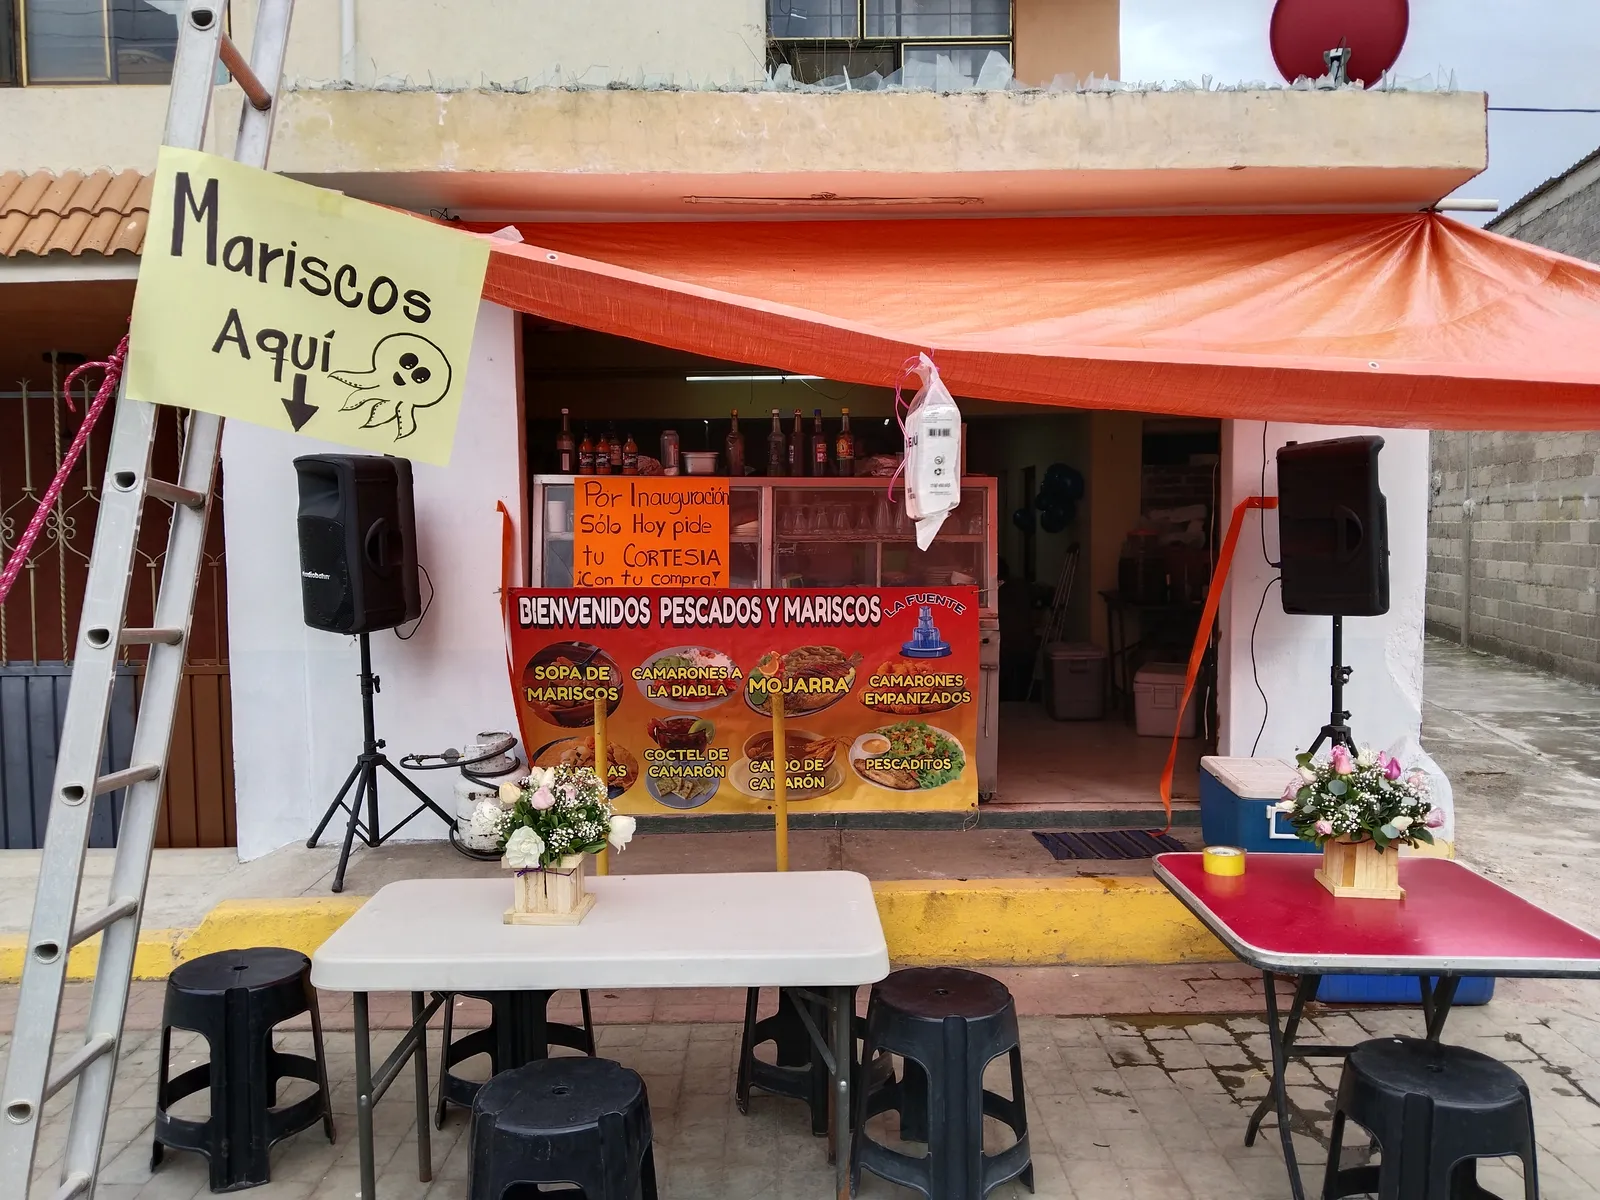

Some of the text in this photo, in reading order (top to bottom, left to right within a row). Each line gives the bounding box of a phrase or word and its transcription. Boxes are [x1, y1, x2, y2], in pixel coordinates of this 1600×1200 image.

[170, 171, 432, 324] Mariscos
[211, 308, 336, 383] Aquí
[584, 481, 729, 515] Por Inauguración
[580, 513, 712, 541] Sólo Hoy pide
[583, 543, 721, 567] tu CORTESIA
[577, 570, 721, 588] ¡Con tu compra!
[518, 595, 881, 626] BIENVENIDOS PESCADOS Y MARISCOS
[884, 593, 967, 618] LA FUENTE
[534, 666, 611, 681] SOPA DE
[631, 667, 743, 680] CAMARONES A
[869, 674, 964, 688] CAMARONES
[647, 684, 728, 698] LA DIABLA
[749, 677, 850, 694] MOJARRA
[527, 687, 619, 702] MARISCOS
[864, 691, 971, 705] EMPANIZADOS
[644, 748, 729, 761] COCTEL DE
[648, 763, 725, 778] CAMARÓN
[749, 759, 824, 773] CALO DE
[865, 758, 952, 770] PESCADITOS
